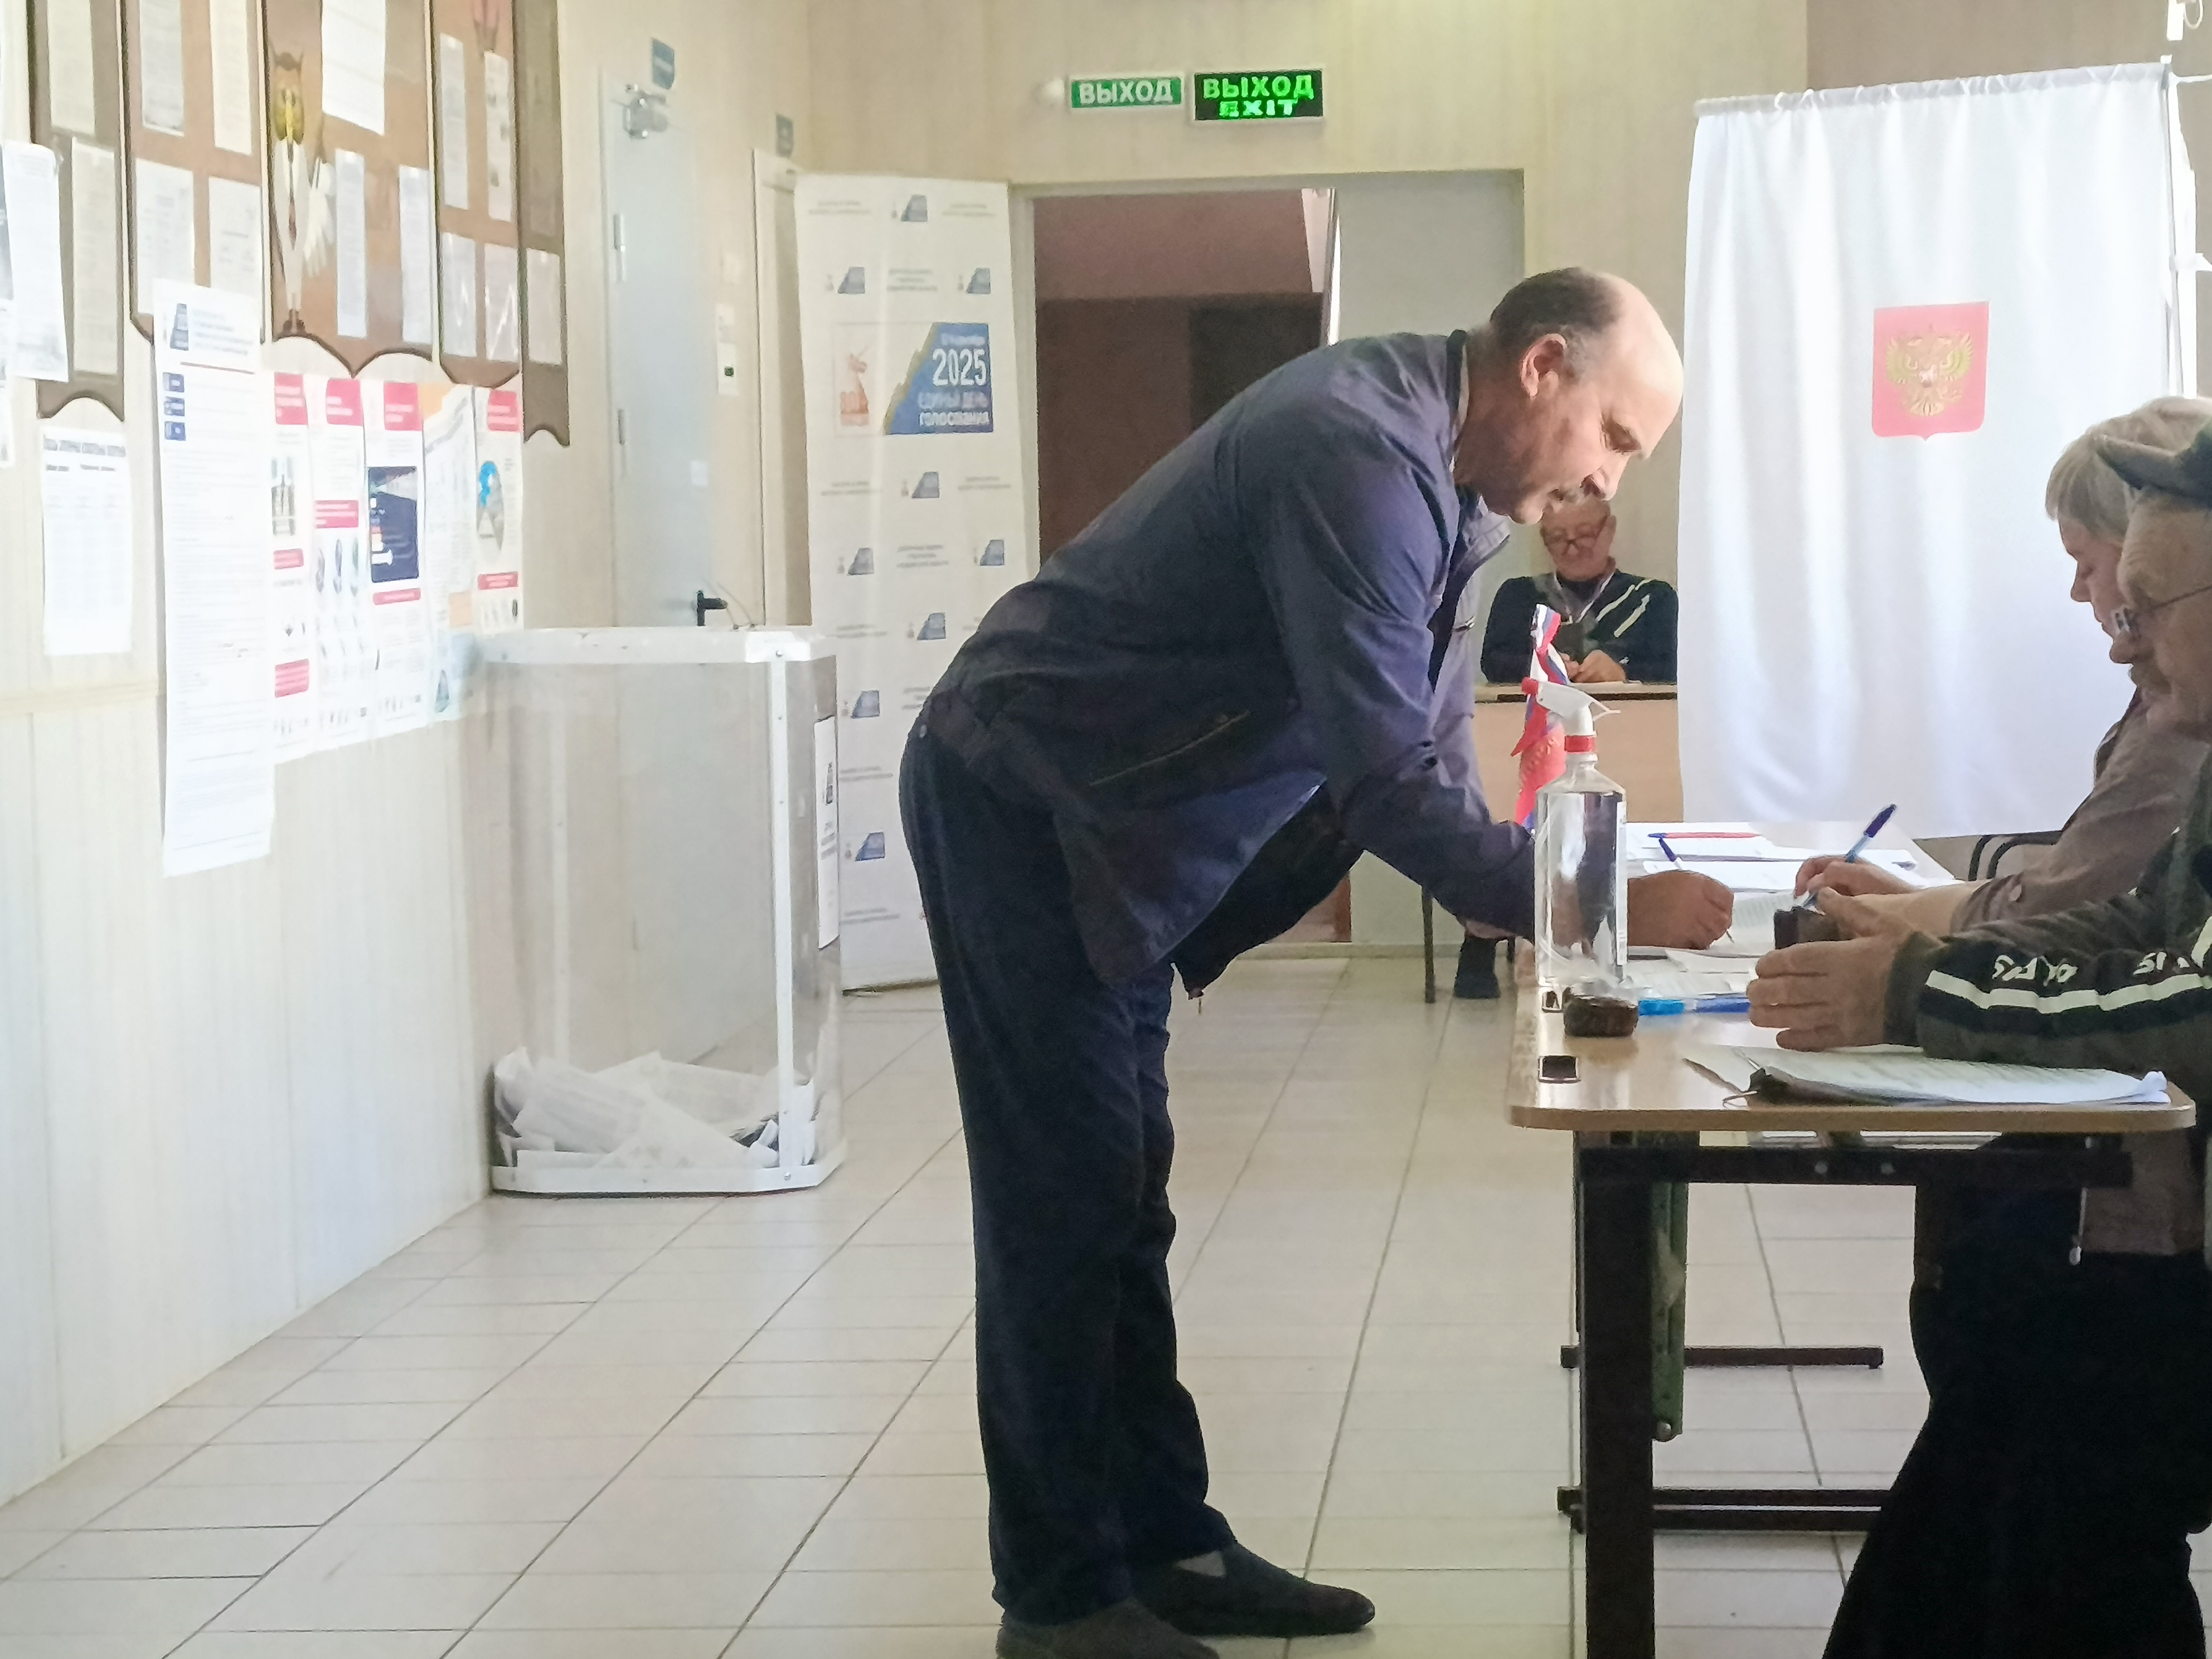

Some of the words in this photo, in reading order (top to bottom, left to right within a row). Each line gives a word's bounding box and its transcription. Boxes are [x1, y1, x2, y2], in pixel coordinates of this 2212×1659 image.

[1079, 80, 1172, 104] ВЫХОД
[1204, 75, 1314, 99] ВЫХОД
[1219, 99, 1298, 118] EXIT
[933, 348, 987, 386] 2025
